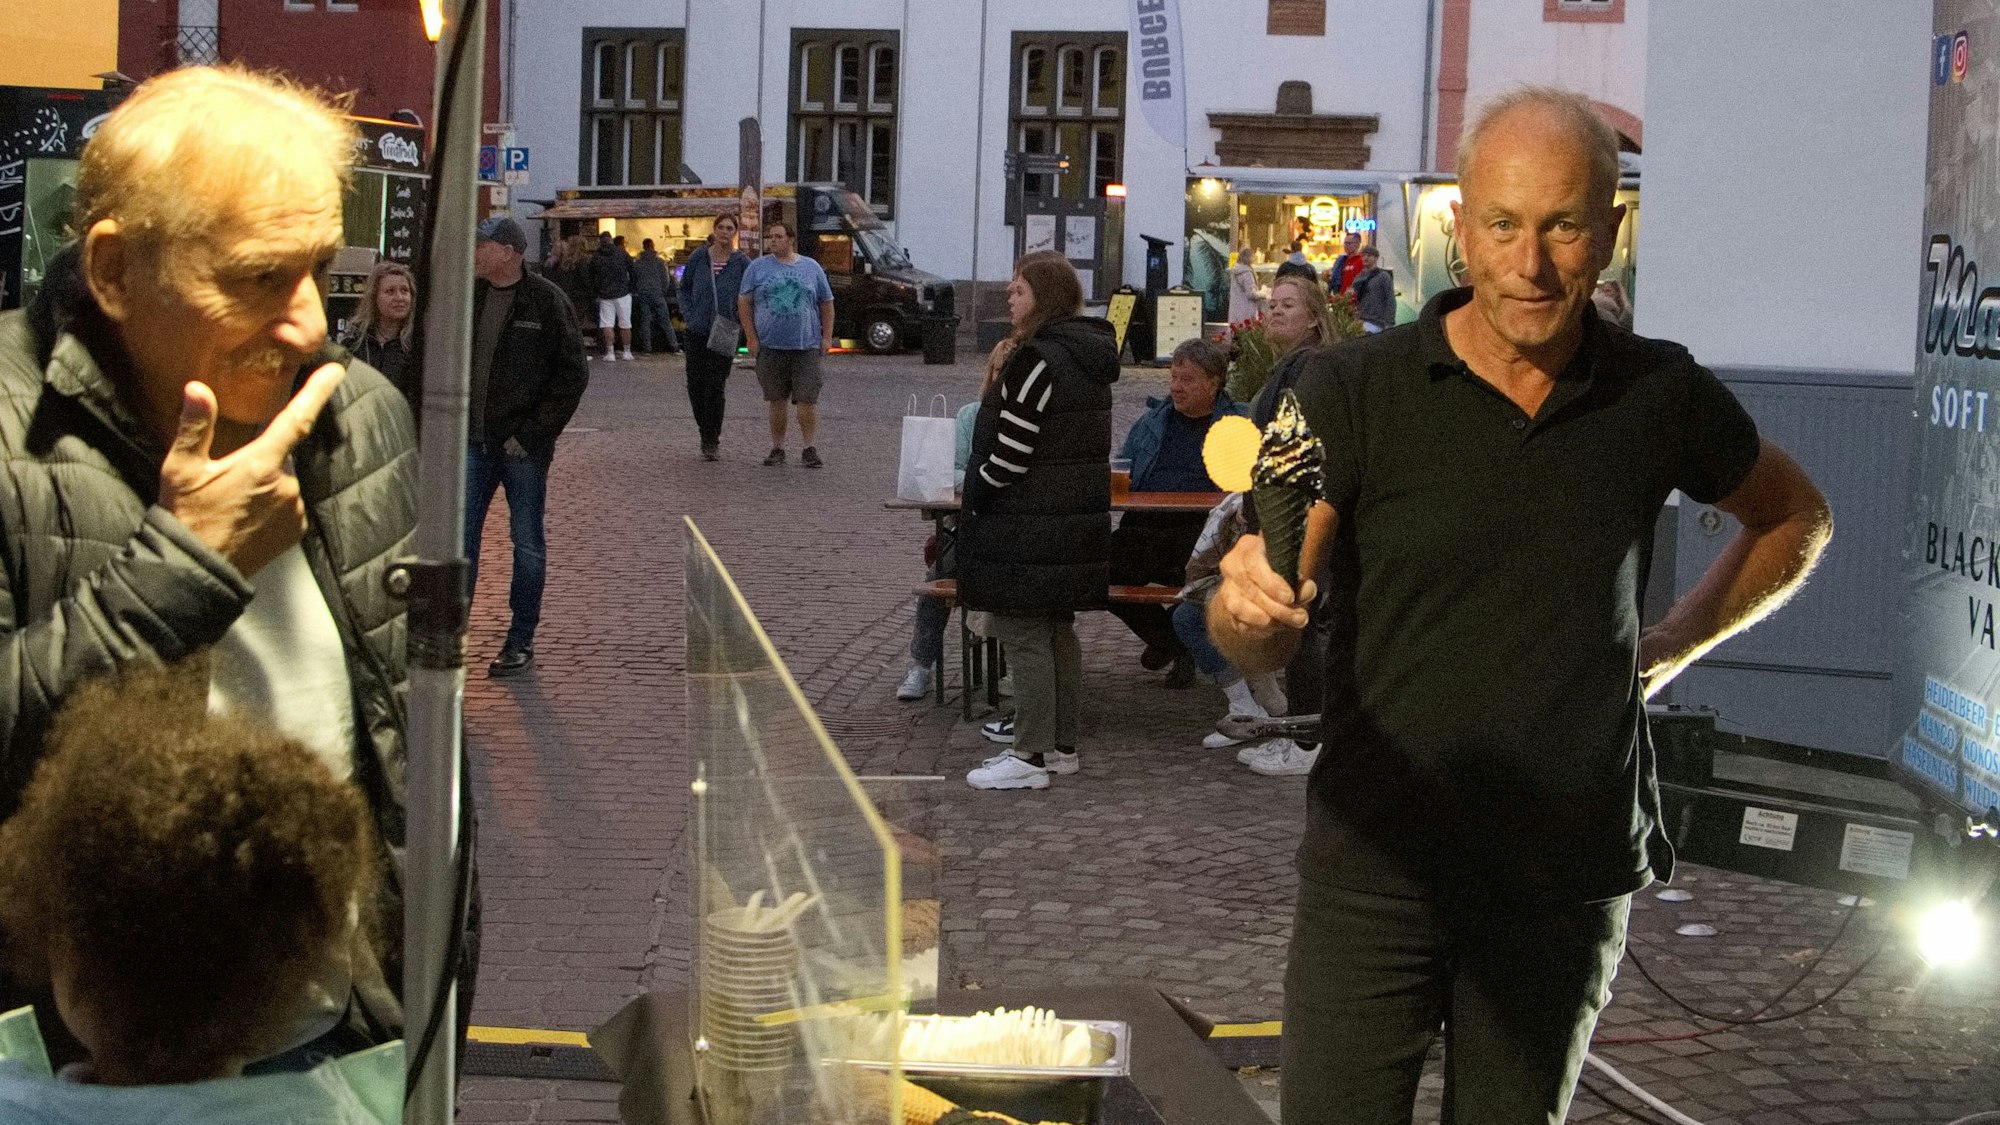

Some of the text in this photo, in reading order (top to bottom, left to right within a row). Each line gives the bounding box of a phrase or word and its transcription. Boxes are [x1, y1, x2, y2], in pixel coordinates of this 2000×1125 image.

[1137, 0, 1171, 100] BURGE
[511, 149, 525, 169] P
[1931, 385, 1988, 432] SOFT
[1926, 521, 2000, 588] BLACK
[1968, 595, 1995, 650] VA
[1926, 679, 1985, 729] HEIDELBEER
[1920, 711, 1955, 750] MANGO
